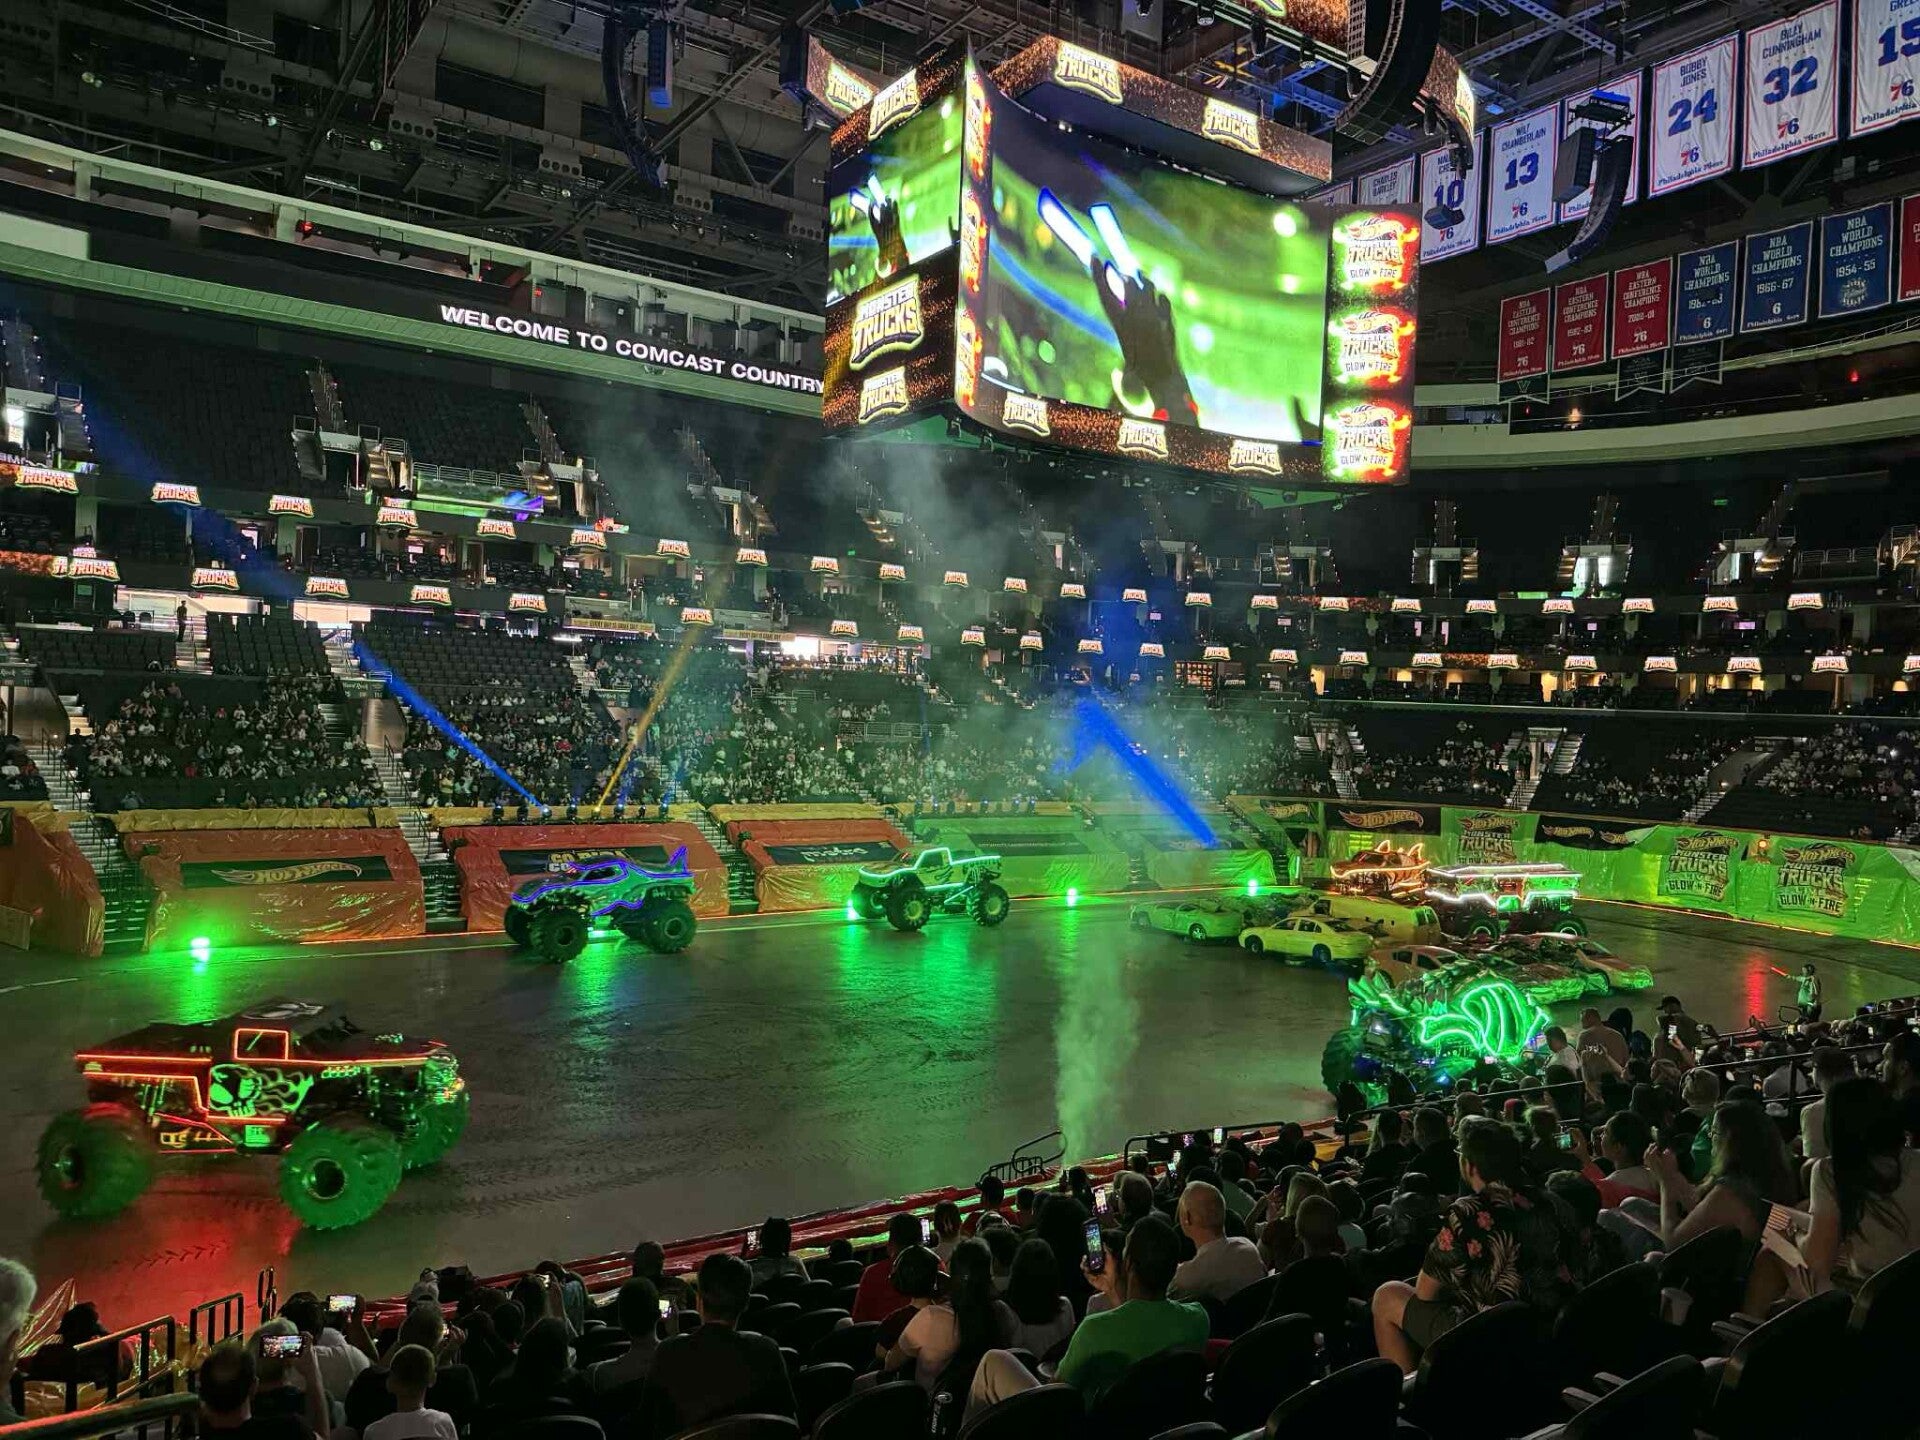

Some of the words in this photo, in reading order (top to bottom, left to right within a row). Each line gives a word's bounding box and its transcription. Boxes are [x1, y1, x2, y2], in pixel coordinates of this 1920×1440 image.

[1780, 22, 1803, 42] BILLY
[1762, 29, 1822, 59] CUNNINGHAM
[1878, 16, 1920, 67] 15
[1680, 57, 1707, 77] BOBBY
[1058, 58, 1121, 96] TRUCKS
[1680, 68, 1707, 87] JONES
[1763, 56, 1818, 105] 32
[1890, 80, 1914, 101] 76
[872, 80, 918, 132] TRUCKS
[1668, 88, 1718, 136] 24
[1861, 102, 1917, 124] Philadelphia
[1203, 114, 1258, 147] TRUCKS
[1516, 123, 1531, 135] WILT
[1777, 118, 1799, 139] 76
[1501, 127, 1546, 151] CHAMBERLAIN
[1680, 147, 1699, 166] 76
[1753, 139, 1802, 159] Philadelphia
[1504, 151, 1539, 190] 13
[1657, 166, 1701, 186] Philadelphia
[1434, 180, 1464, 209] 10
[1511, 202, 1527, 218] 76
[1494, 219, 1530, 235] Philadelphia
[1847, 216, 1867, 230] NBA
[1439, 226, 1454, 241] 76
[1769, 235, 1787, 247] NBA
[1841, 226, 1873, 243] WORLD
[1763, 246, 1793, 261] WORLD
[1829, 235, 1883, 258] CHAMPIONS
[1348, 246, 1402, 264] TRUCKS
[1699, 253, 1716, 265] NBA
[1694, 263, 1721, 276] WORLD
[1752, 255, 1802, 274] CHAMPIONS
[1835, 259, 1876, 278] 1954-55
[1350, 269, 1371, 279] GLOW
[1379, 269, 1397, 279] FIRE
[1684, 272, 1730, 291] CHAMPIONS
[1629, 276, 1656, 291] EASTERN
[1756, 278, 1794, 294] 1966-67
[1568, 292, 1593, 306] EASTERN
[1623, 284, 1661, 300] CONFERENCE
[861, 281, 914, 320] MONSTER
[1563, 299, 1598, 315] CONFERENCE
[1624, 294, 1660, 308] CHAMPIONS
[1564, 309, 1597, 323] CHAMPIONS
[852, 298, 921, 362] TRUCKS
[1634, 331, 1647, 343] 76
[440, 303, 570, 345] WELCOME
[576, 331, 608, 351] TO
[615, 340, 725, 375] COMCAST
[730, 363, 825, 394] COUNTRY
[1343, 341, 1398, 358] TRUCKS
[1345, 363, 1366, 373] GLOW
[1374, 363, 1392, 373] FIRE
[861, 382, 907, 419] TRUCKS
[1005, 404, 1048, 430] TRUCKS
[1120, 427, 1166, 454] TRUCKS
[1338, 434, 1393, 452] TRUCKS
[1230, 448, 1281, 471] TRUCKS
[1340, 455, 1361, 465] GLOW
[1370, 455, 1388, 465] FIRE
[154, 489, 198, 503] TRUCKS
[270, 501, 313, 515] TRUCKS
[378, 513, 417, 527] TRUCKS
[478, 524, 515, 538] TRUCKS
[571, 532, 606, 546] TRUCKS
[658, 542, 689, 556] TRUCKS
[738, 552, 768, 564] TRUCKS
[812, 560, 839, 572] TRUCKS
[71, 564, 117, 578] TRUCKS
[880, 567, 905, 578] TRUCKS
[193, 573, 237, 587] TRUCKS
[307, 583, 348, 597] TRUCKS
[412, 589, 450, 604] TRUCKS
[510, 598, 546, 612] TRUCKS
[682, 612, 712, 624] TRUCKS
[1362, 814, 1385, 827] HOT
[1385, 810, 1418, 824] WHEELS
[1464, 830, 1511, 839] MONSTER
[1460, 837, 1512, 851] TRUCKS
[1690, 837, 1707, 849] HOT
[1675, 850, 1728, 861] MONSTER
[1800, 850, 1817, 862] HOT
[1669, 856, 1727, 875] TRUCKS
[1784, 862, 1843, 874] MONSTER
[1778, 869, 1844, 890] TRUCKS
